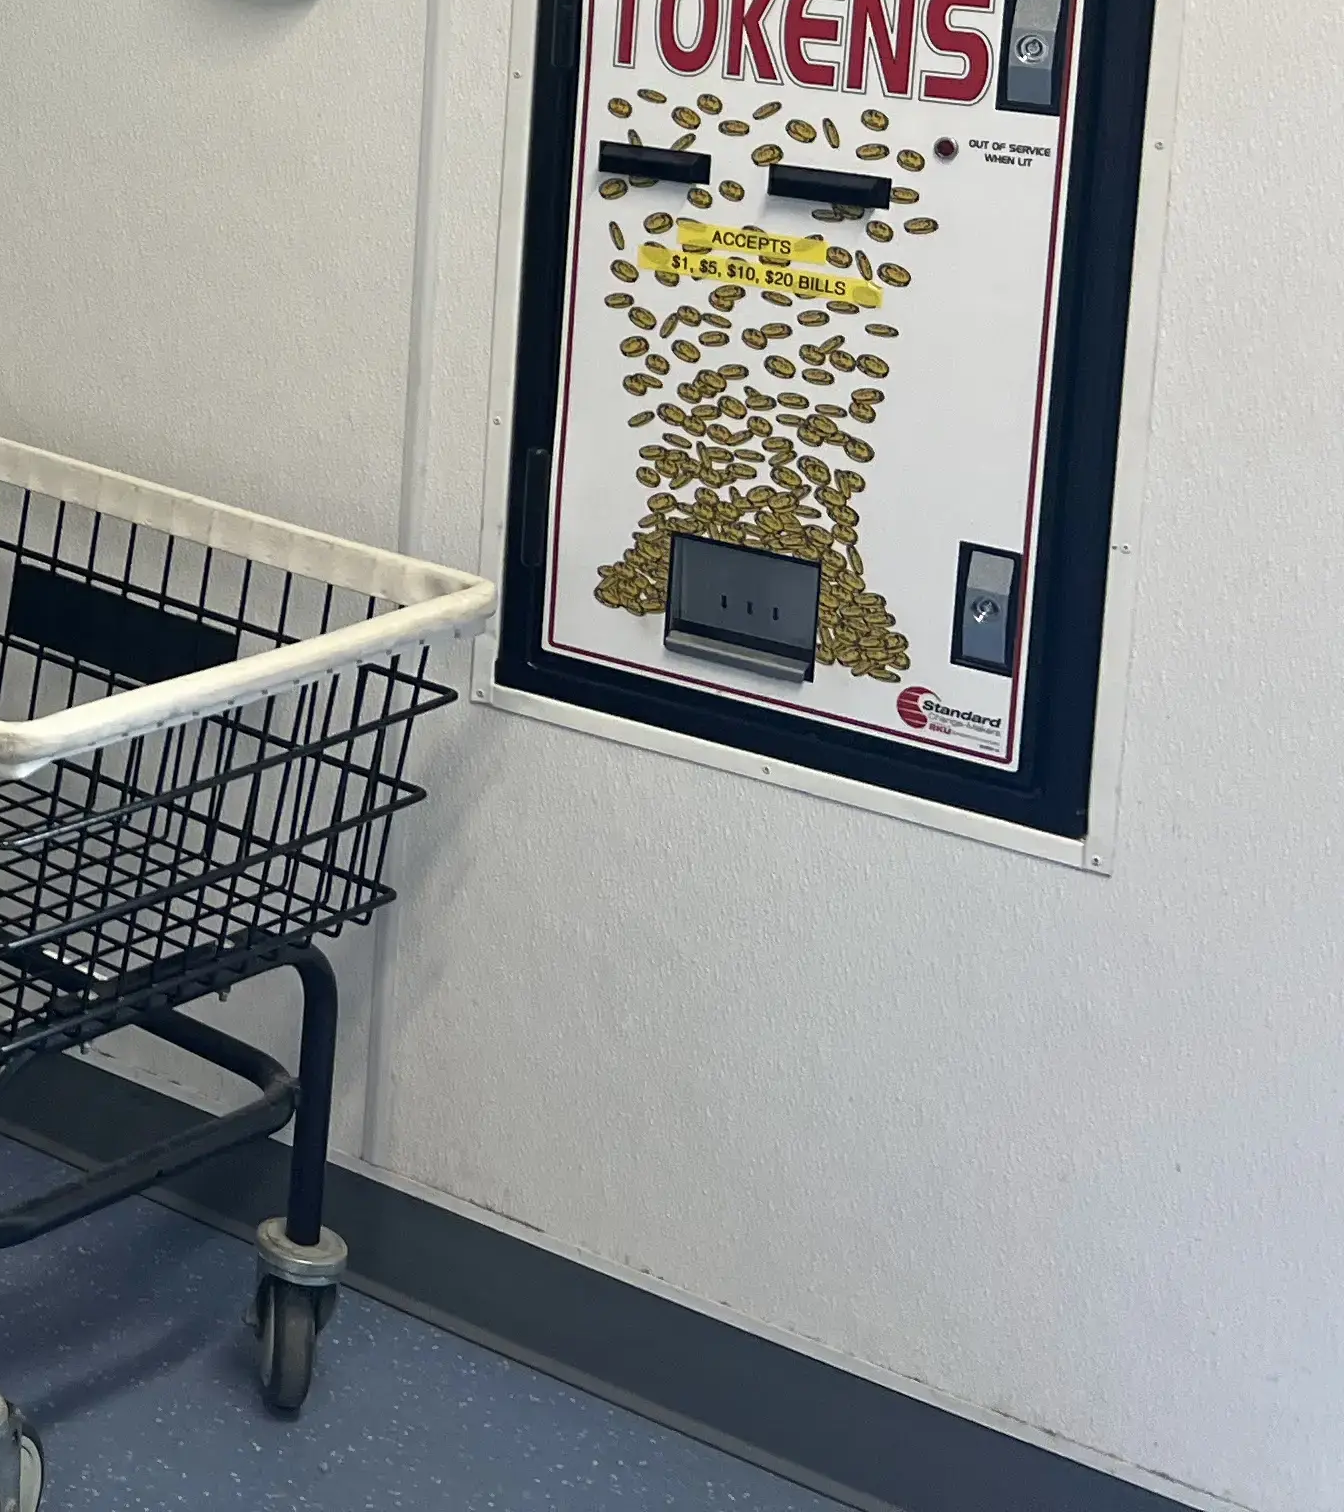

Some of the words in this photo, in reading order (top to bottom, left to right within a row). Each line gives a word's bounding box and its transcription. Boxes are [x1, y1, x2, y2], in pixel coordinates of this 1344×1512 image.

[968, 139, 990, 149] OUT
[991, 142, 1006, 151] OF
[1009, 144, 1051, 157] SERVICE
[984, 153, 1015, 165] WHEN
[1017, 157, 1033, 167] LIT
[712, 230, 791, 255] ACCEPTS
[671, 254, 694, 274] $1,
[699, 258, 722, 278] $5,
[726, 263, 760, 284] $10,
[765, 269, 794, 288] $20
[798, 276, 846, 296] BILLS
[923, 699, 1002, 728] Standard
